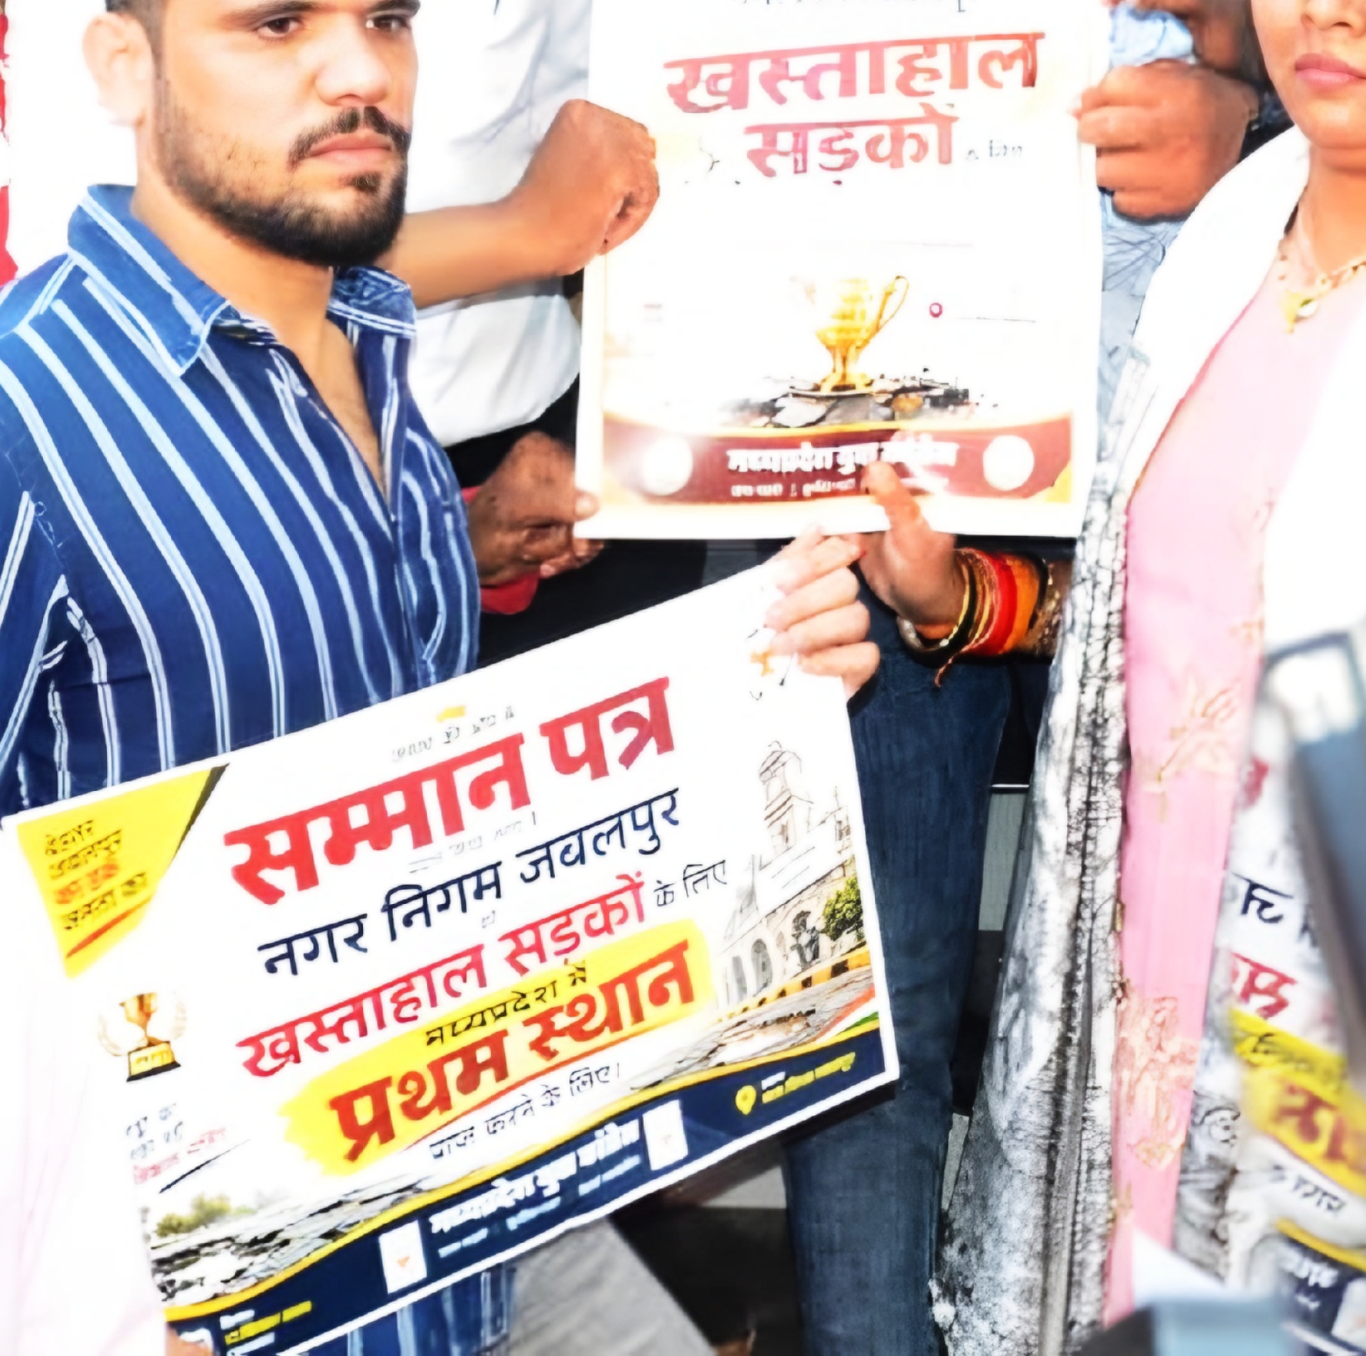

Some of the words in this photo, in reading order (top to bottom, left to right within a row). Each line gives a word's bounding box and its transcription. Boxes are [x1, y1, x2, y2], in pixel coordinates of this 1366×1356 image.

[663, 32, 1045, 114] खस्ताहाल
[744, 101, 959, 185] सड़कों
[224, 732, 532, 905] सम्मान
[539, 676, 675, 781] पत्र
[257, 913, 368, 976] नगर
[381, 860, 503, 941] निगम
[516, 787, 679, 884] जबलपुर
[236, 944, 488, 1078] खस्ताहाल
[498, 870, 645, 977] सड़कों
[654, 878, 676, 908] के
[683, 858, 730, 898] लिए
[329, 1029, 511, 1162] प्रथम
[521, 938, 695, 1062] स्थान
